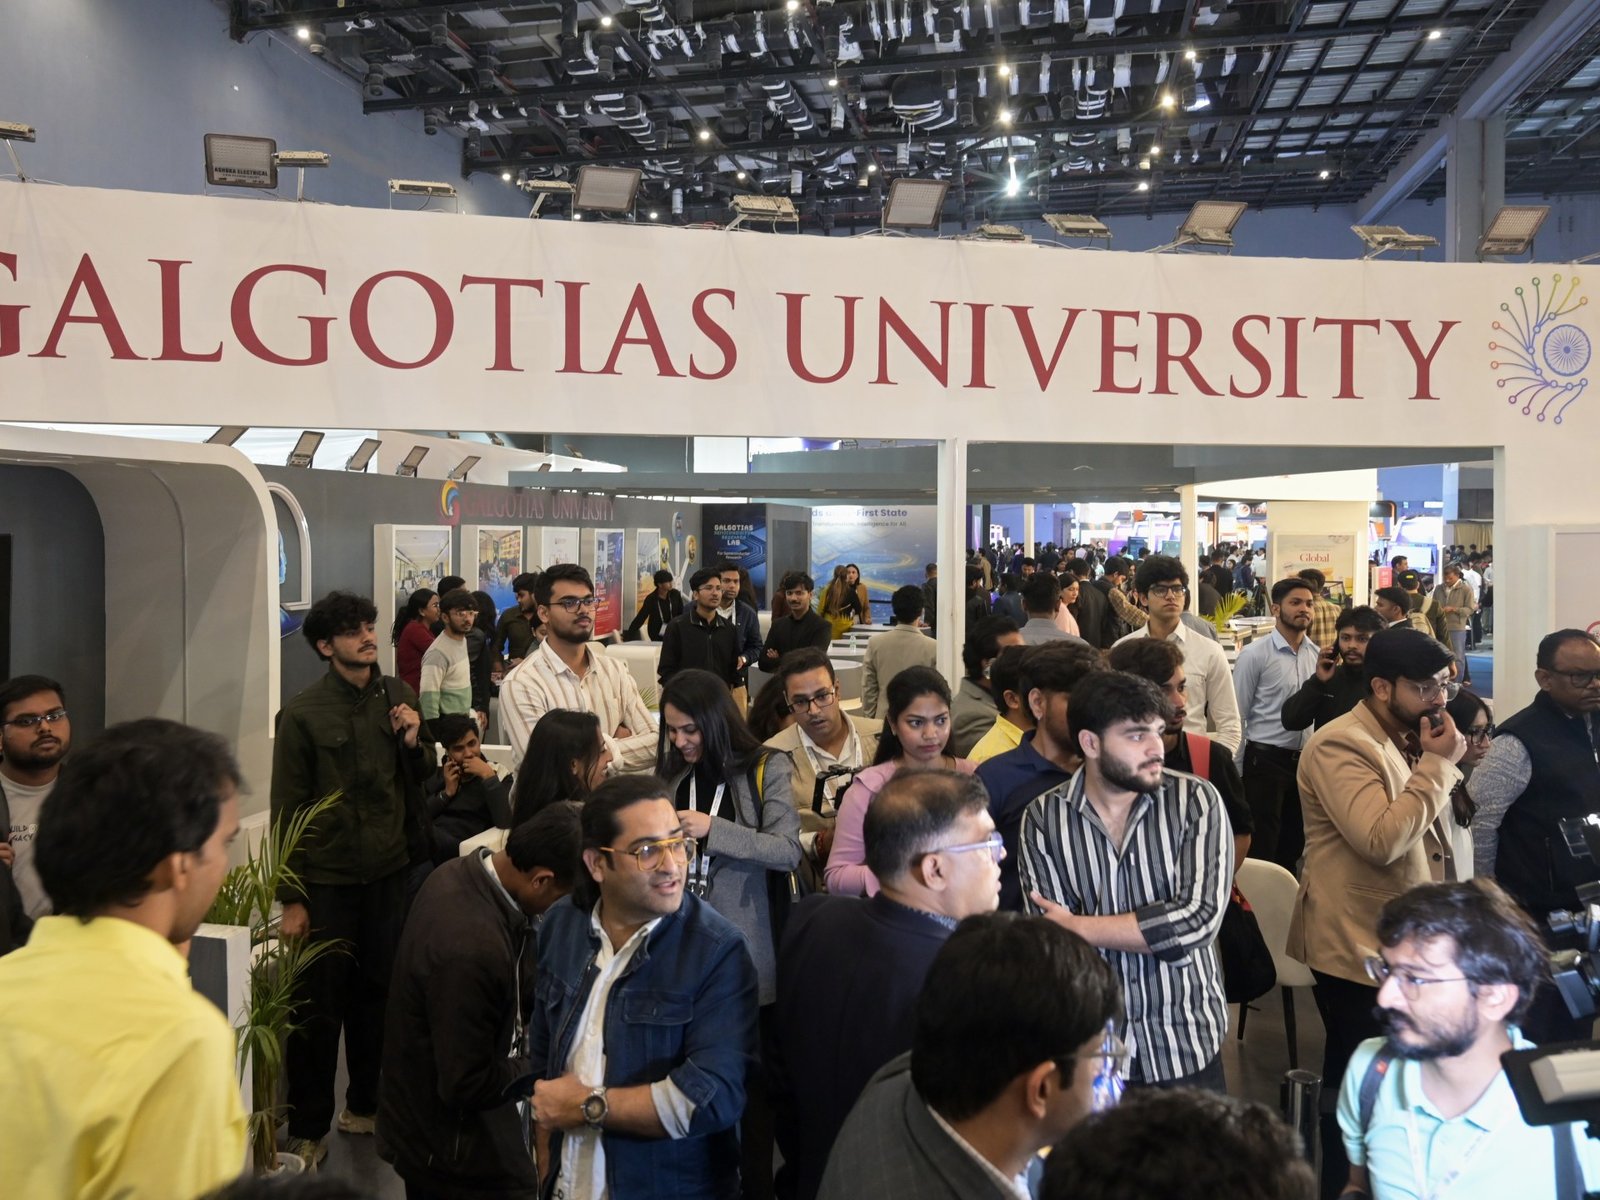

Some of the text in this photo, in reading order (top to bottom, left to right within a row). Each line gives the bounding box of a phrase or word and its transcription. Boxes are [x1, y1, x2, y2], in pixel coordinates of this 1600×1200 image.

[0, 252, 1460, 401] ALGOTIAS UNIVERSITY
[464, 493, 615, 521] GALGOTIAS UNIVERSITY
[857, 508, 879, 517] First
[880, 508, 908, 517] State
[1299, 552, 1330, 562] Global
[11, 833, 33, 841] GACY
